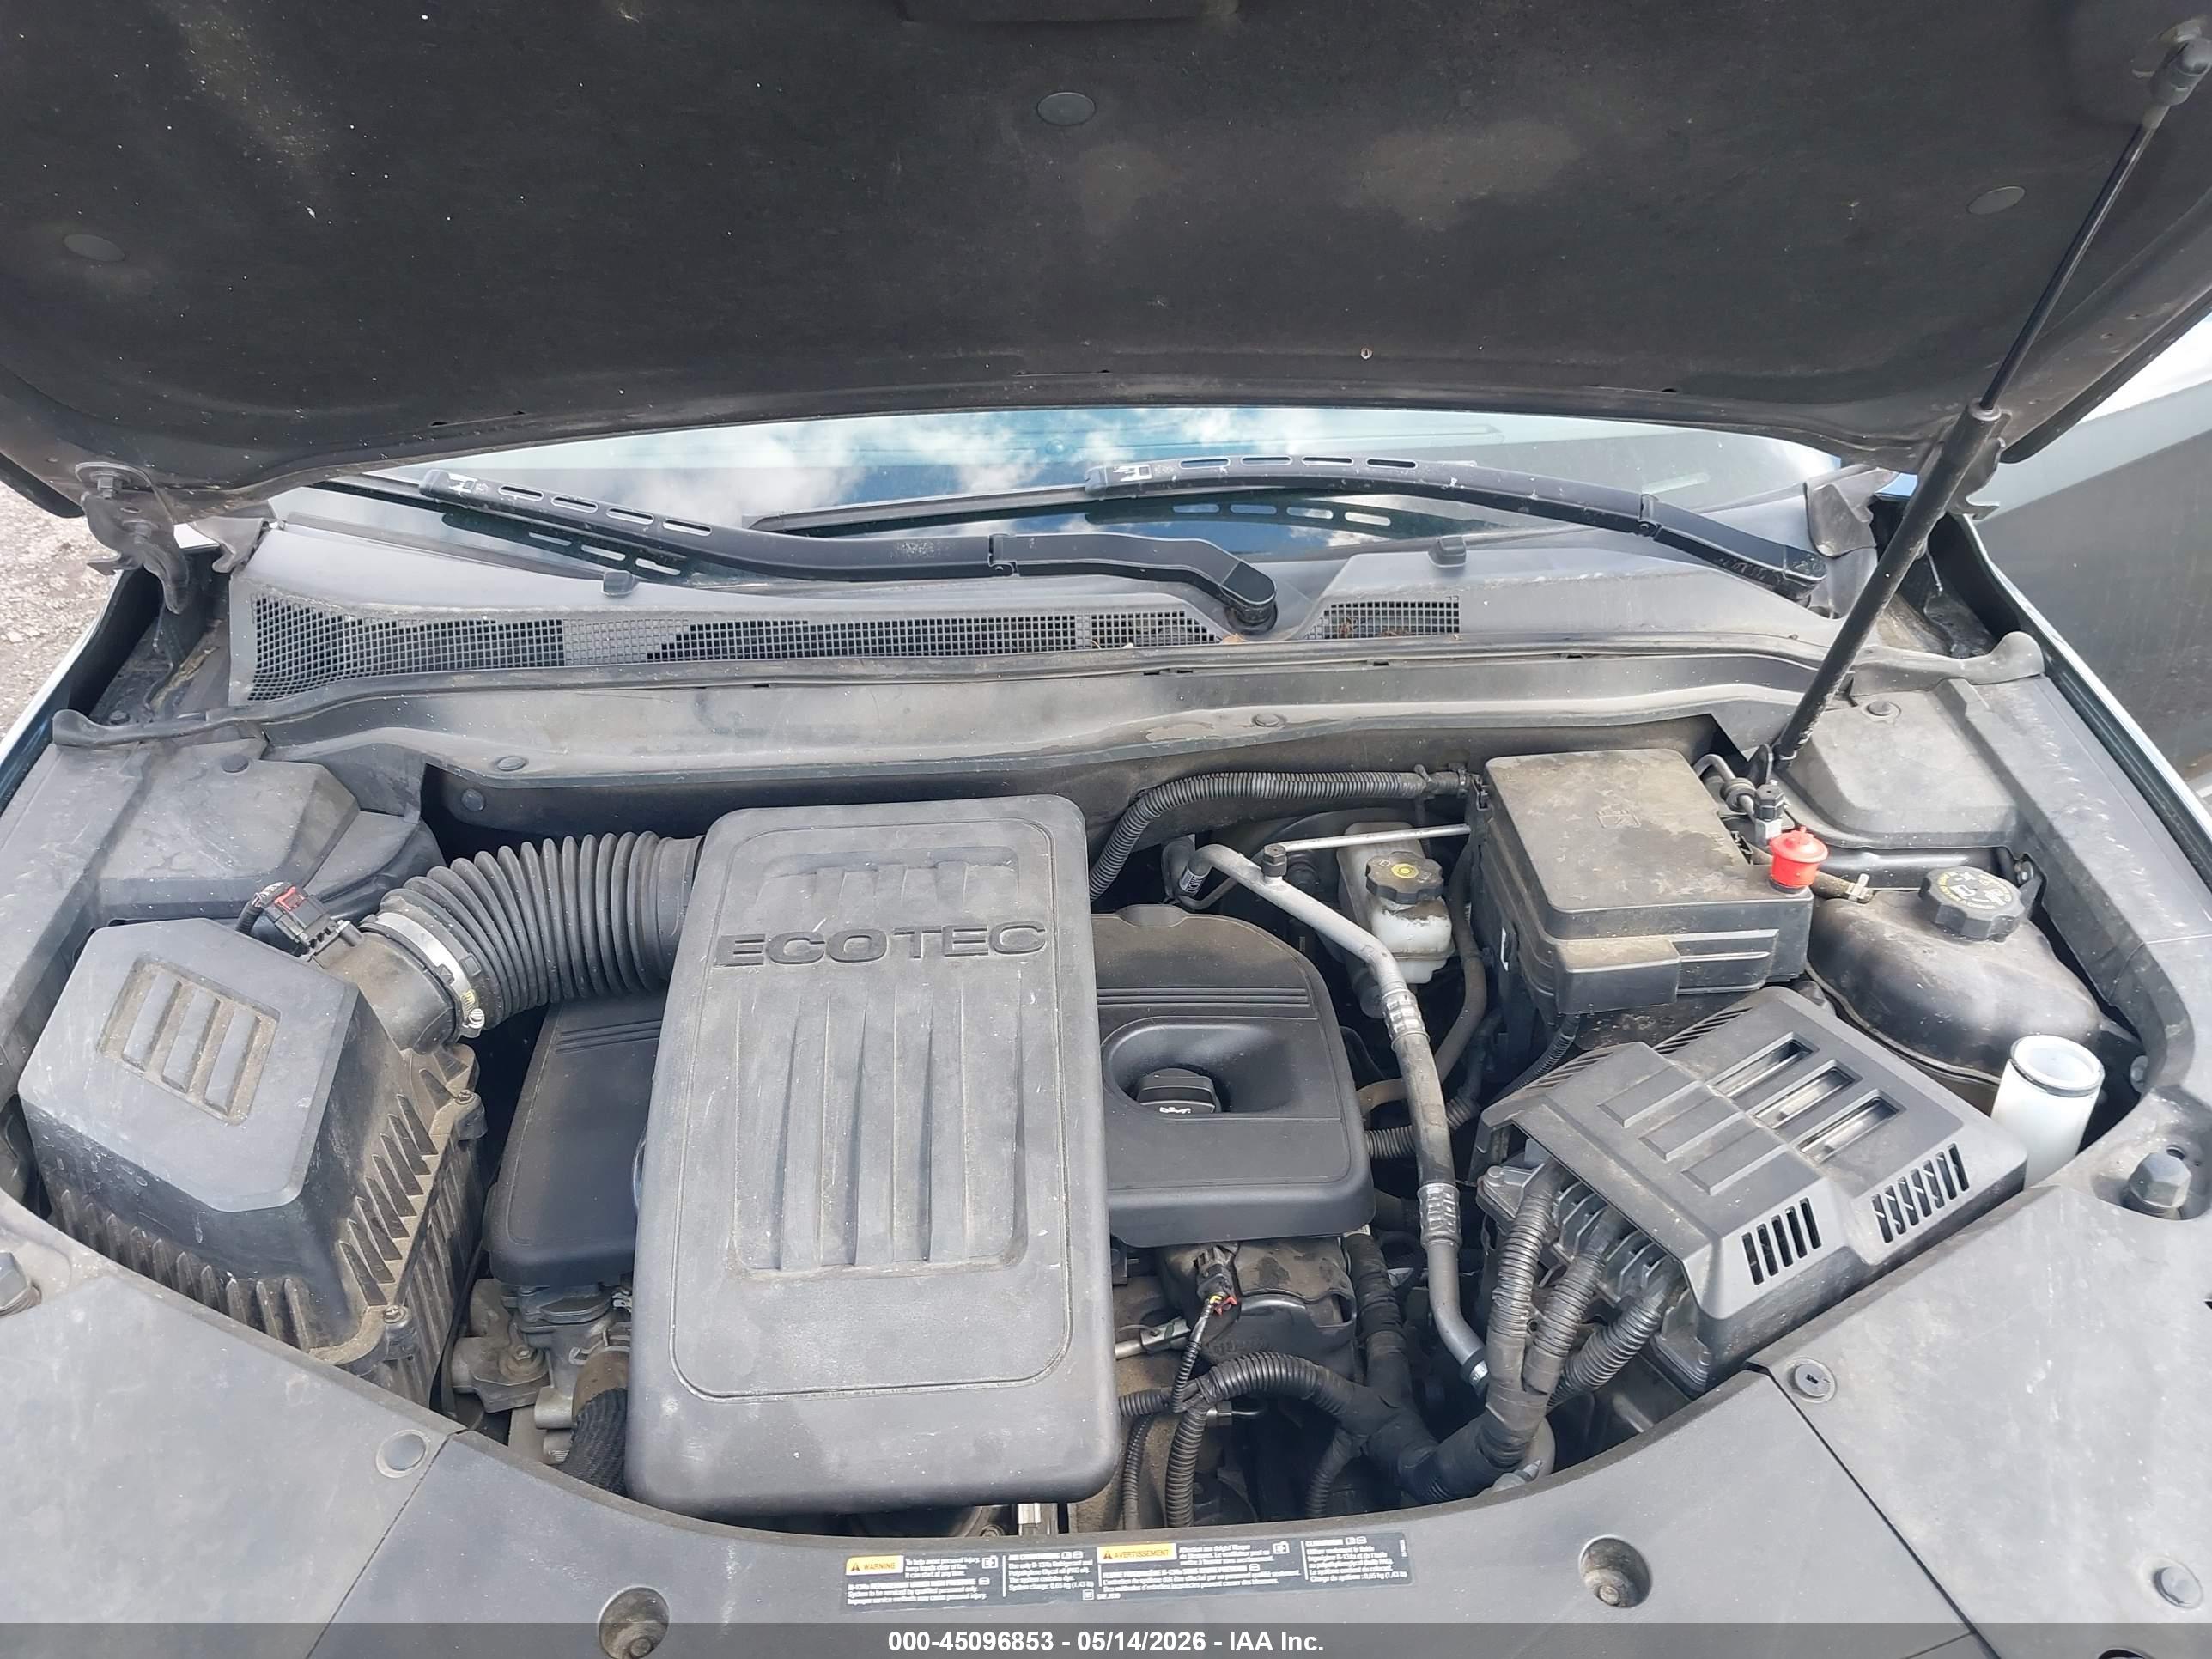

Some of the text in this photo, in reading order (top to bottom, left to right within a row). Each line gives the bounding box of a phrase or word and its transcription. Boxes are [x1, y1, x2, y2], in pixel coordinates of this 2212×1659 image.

[713, 920, 1047, 968] ECOTEC
[1114, 1549, 1169, 1559] AVERTISSEMENT
[863, 1562, 896, 1571] WARNING
